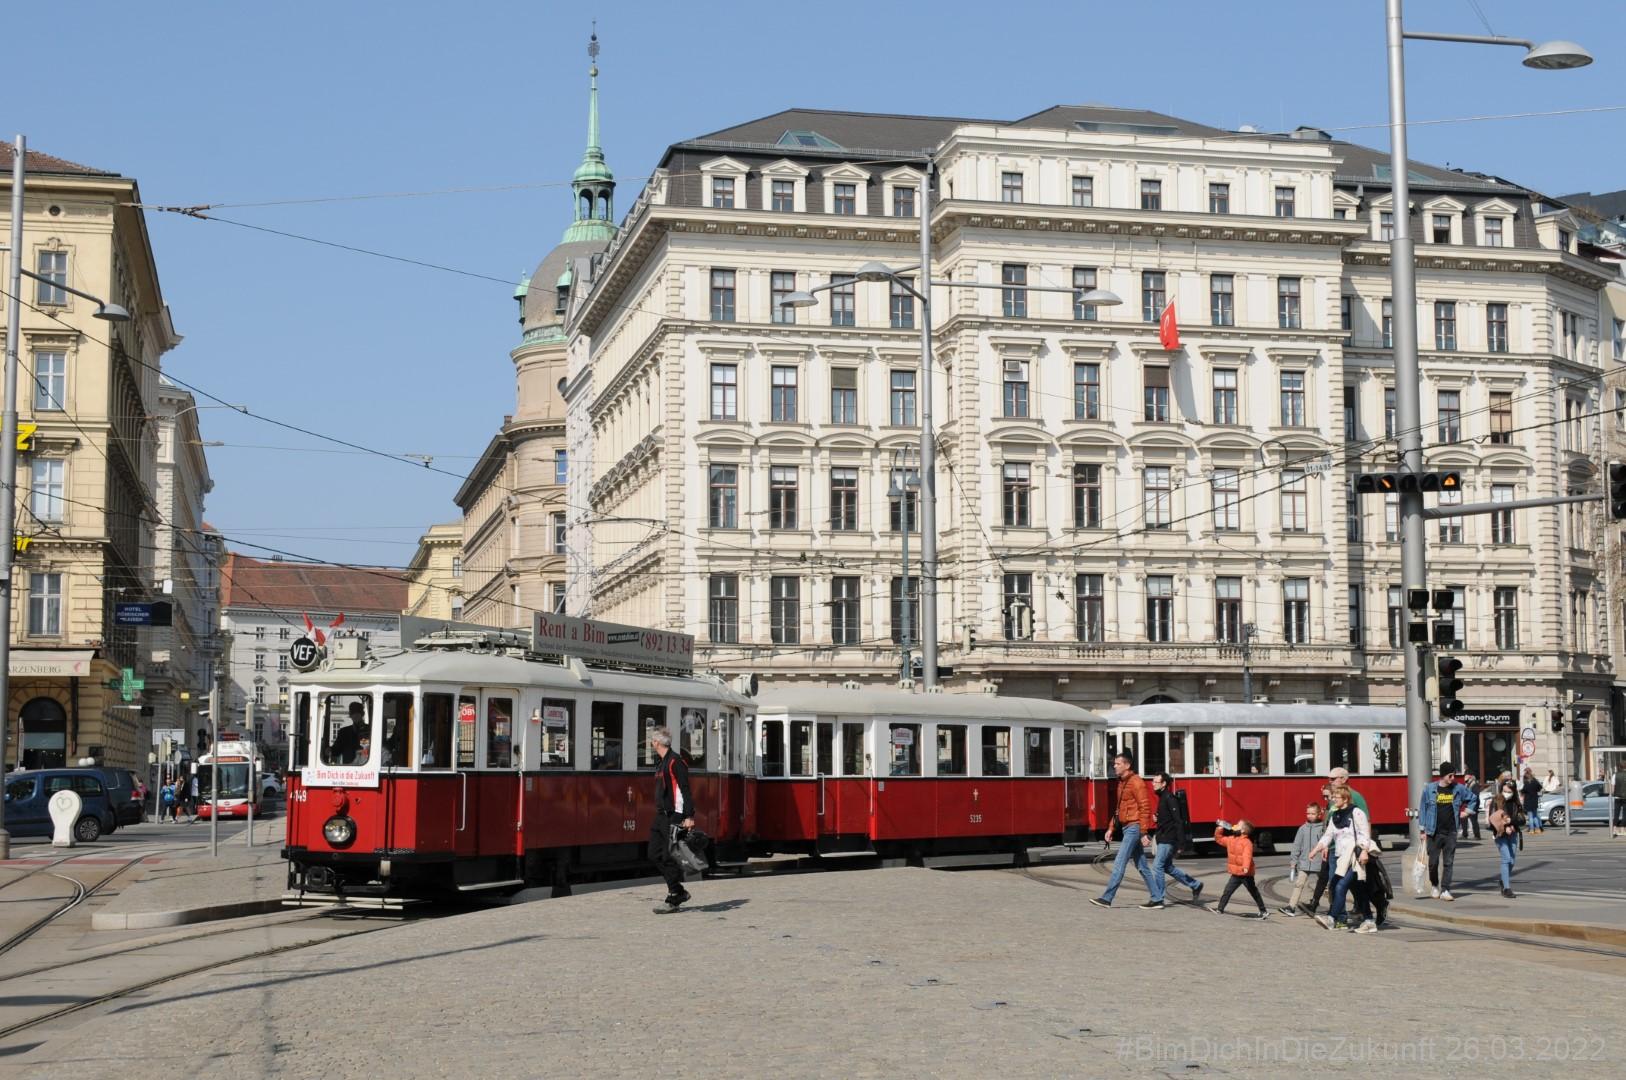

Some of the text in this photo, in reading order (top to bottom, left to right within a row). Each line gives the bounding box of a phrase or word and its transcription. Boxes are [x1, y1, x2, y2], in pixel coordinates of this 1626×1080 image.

[539, 616, 566, 640] Rent
[571, 627, 578, 640] a
[583, 622, 605, 644] Bim
[645, 632, 662, 651] 892
[667, 635, 676, 654] 13
[679, 638, 690, 656] 34
[293, 644, 314, 661] VEF
[317, 770, 326, 780] Bim
[355, 770, 375, 780] Zukunft
